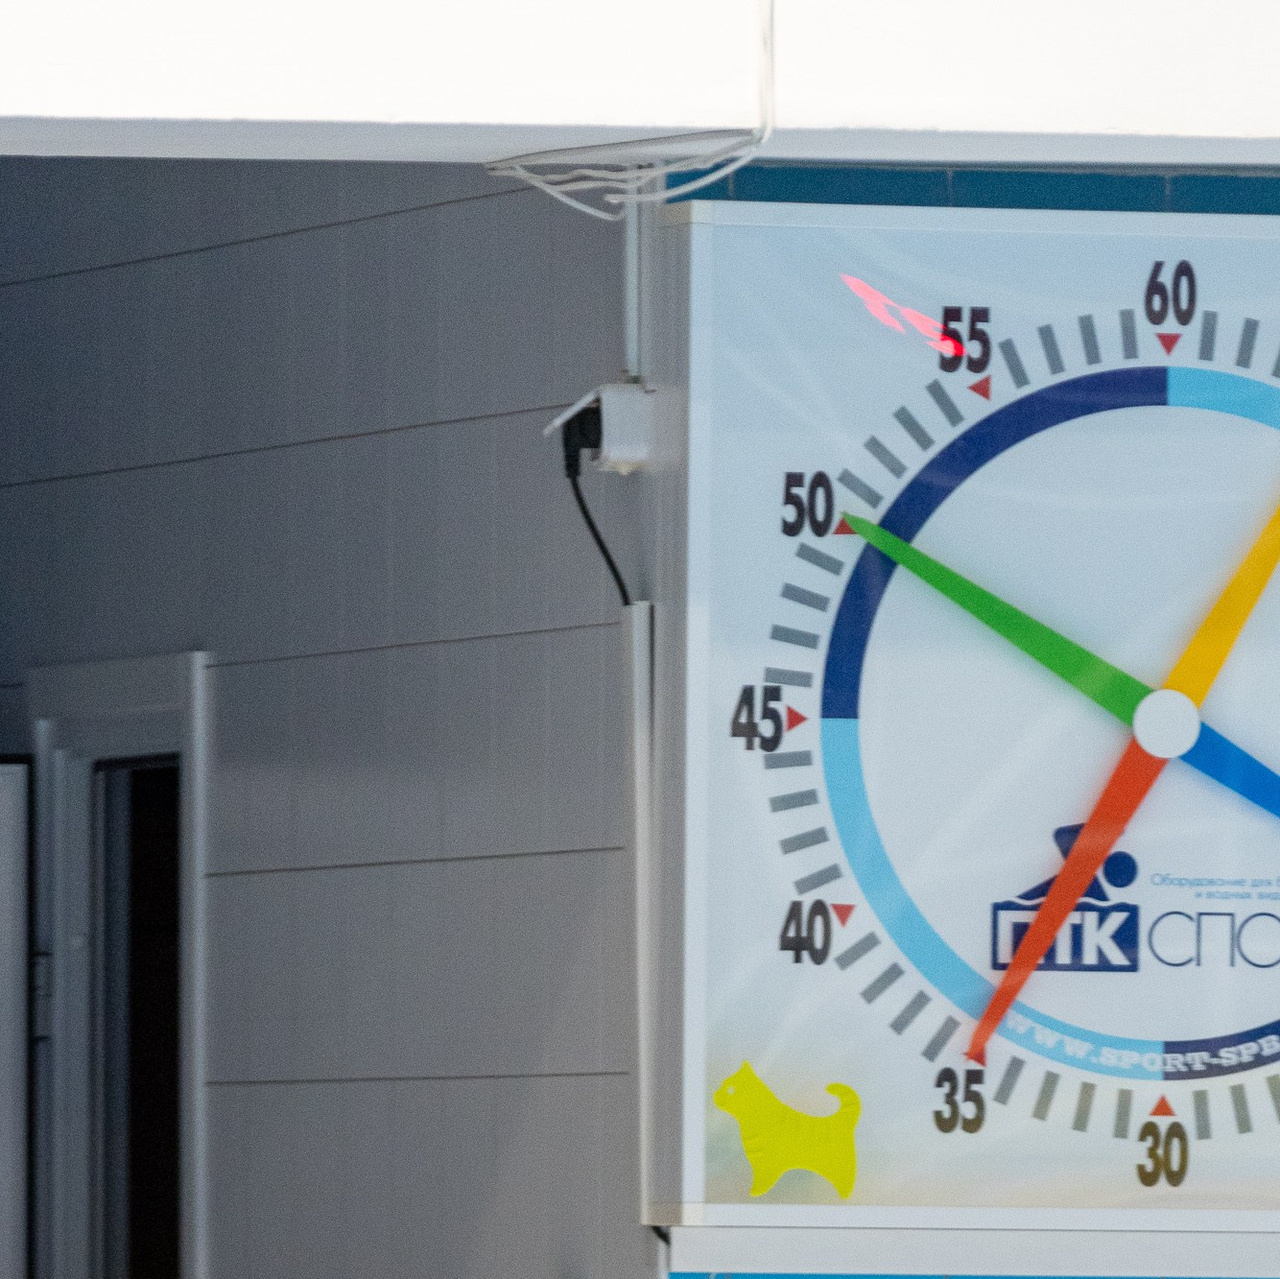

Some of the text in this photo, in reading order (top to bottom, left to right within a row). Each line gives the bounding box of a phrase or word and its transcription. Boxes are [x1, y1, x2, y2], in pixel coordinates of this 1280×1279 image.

[1144, 259, 1197, 326] 60
[939, 305, 992, 374] 55
[781, 470, 835, 538] 50
[731, 685, 784, 753] 45
[779, 899, 832, 966] 40
[933, 1067, 985, 1134] 35
[1137, 1121, 1189, 1187] 30
